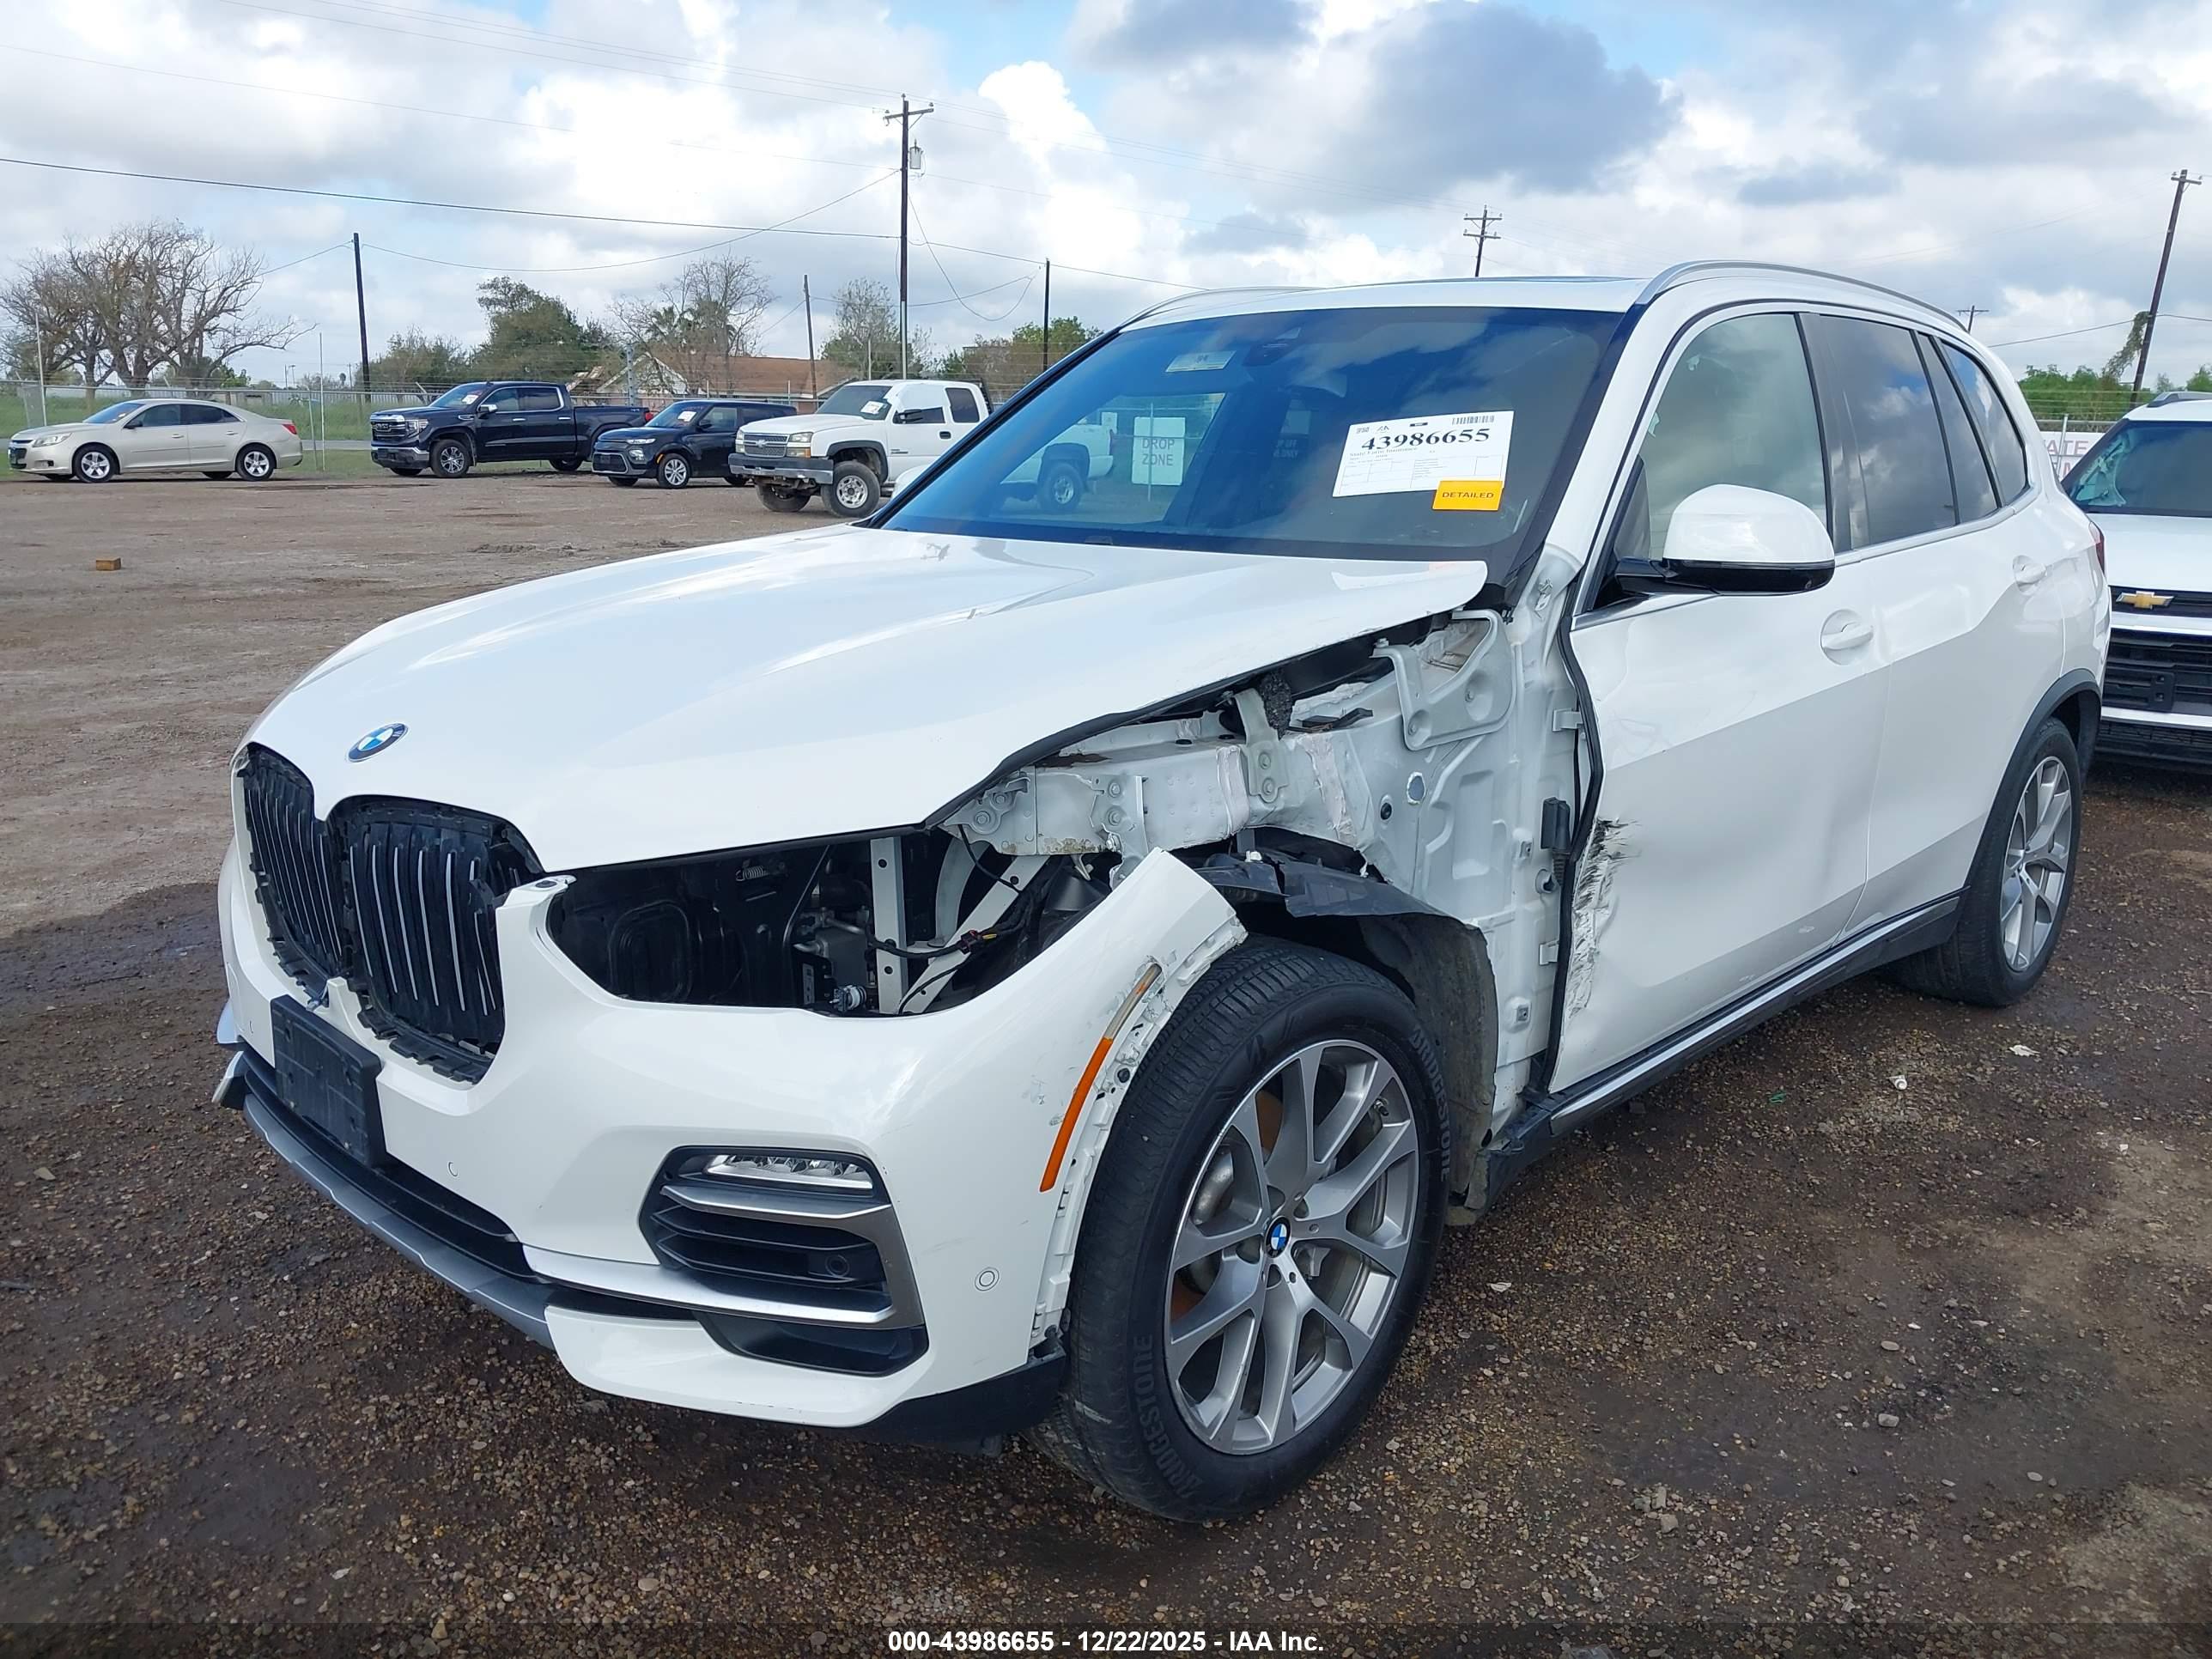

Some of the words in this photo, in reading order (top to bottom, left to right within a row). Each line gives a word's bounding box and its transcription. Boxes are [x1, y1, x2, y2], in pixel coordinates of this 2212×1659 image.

[1142, 438, 1176, 450] DROP
[1361, 428, 1491, 450] 43986655
[2044, 440, 2089, 456] ATE
[1141, 453, 1175, 466] ZONE
